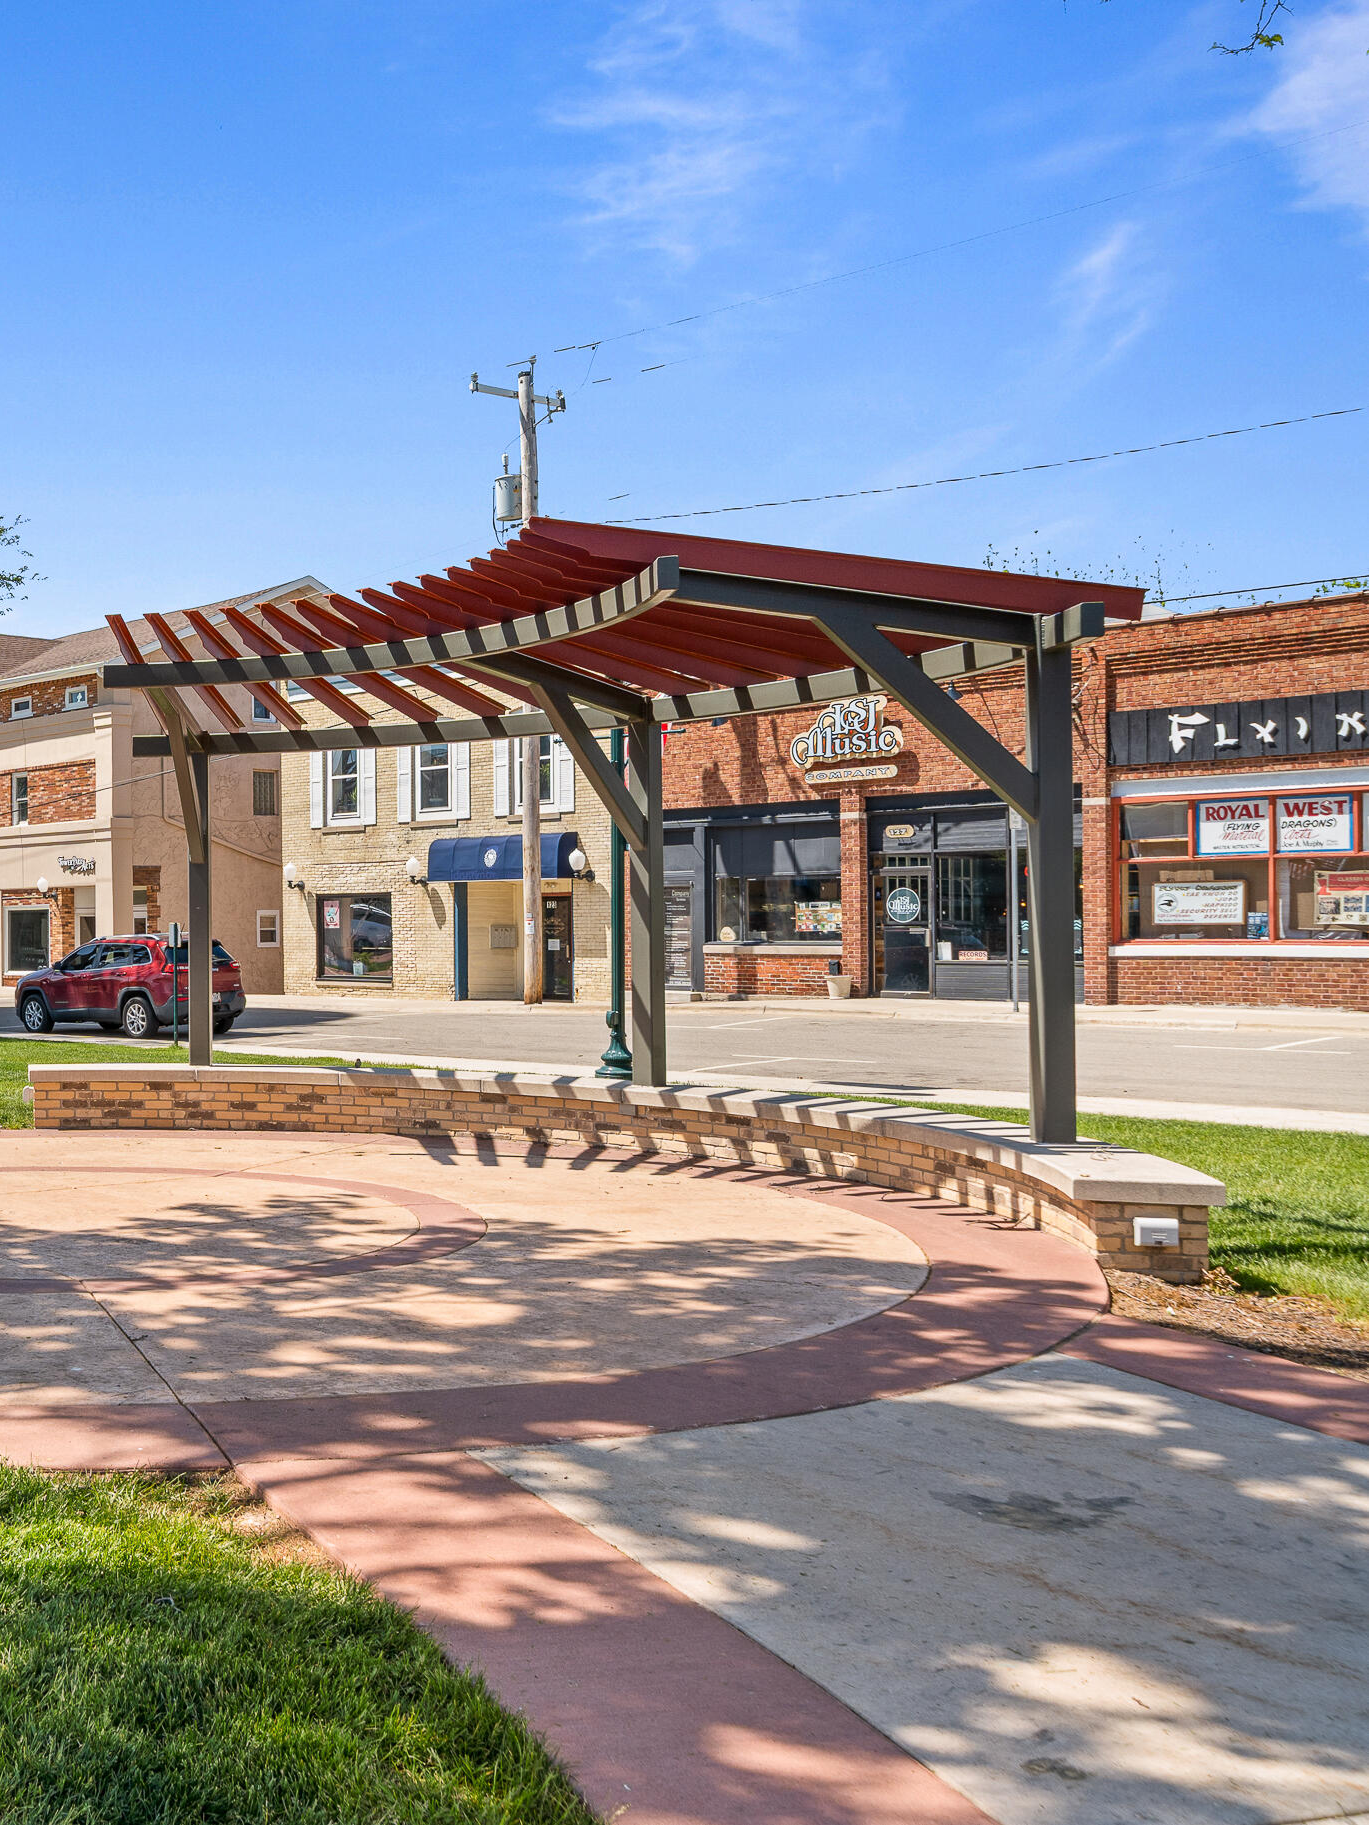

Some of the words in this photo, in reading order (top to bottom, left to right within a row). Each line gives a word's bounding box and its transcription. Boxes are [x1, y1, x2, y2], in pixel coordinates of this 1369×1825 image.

[792, 727, 897, 764] Music
[805, 766, 890, 780] COMPANY
[1205, 804, 1265, 821] ROYAL
[1283, 800, 1347, 817] WEST
